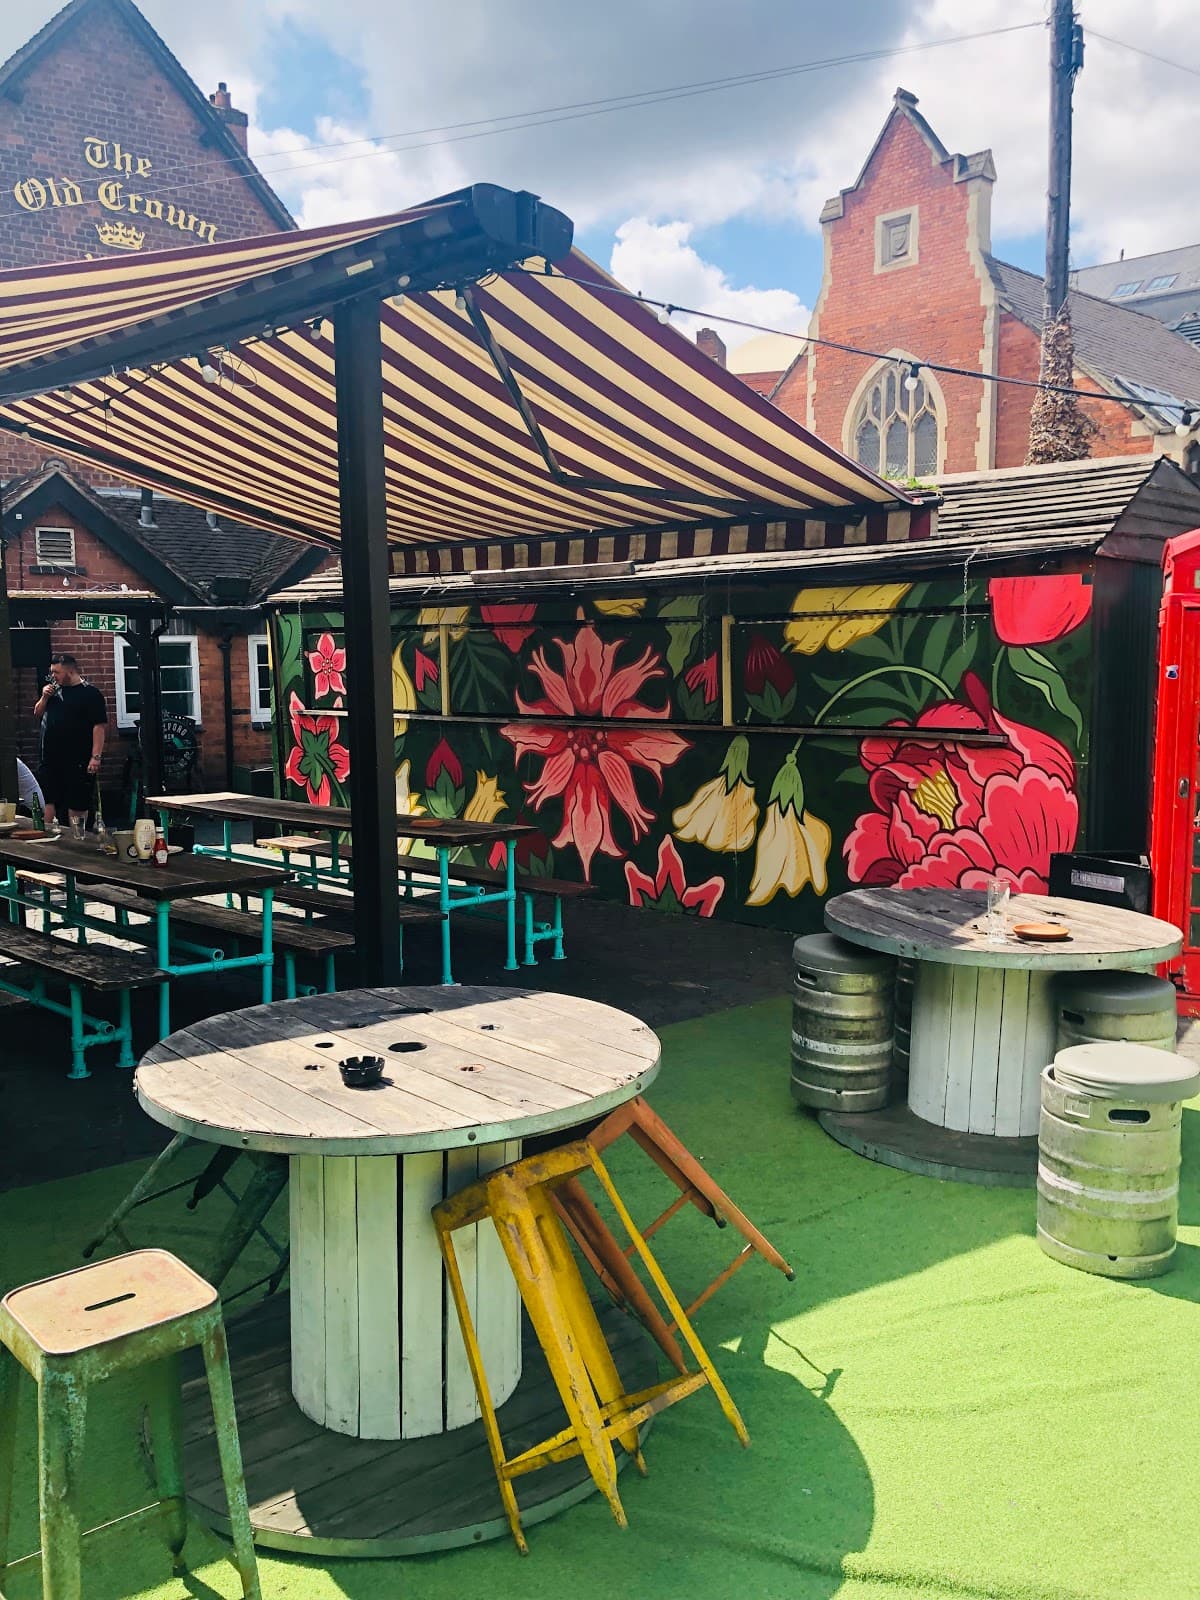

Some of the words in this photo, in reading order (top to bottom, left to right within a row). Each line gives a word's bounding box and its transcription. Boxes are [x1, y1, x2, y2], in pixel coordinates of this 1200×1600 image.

[83, 136, 153, 180] The
[14, 176, 84, 212] Old
[98, 180, 219, 244] Crown
